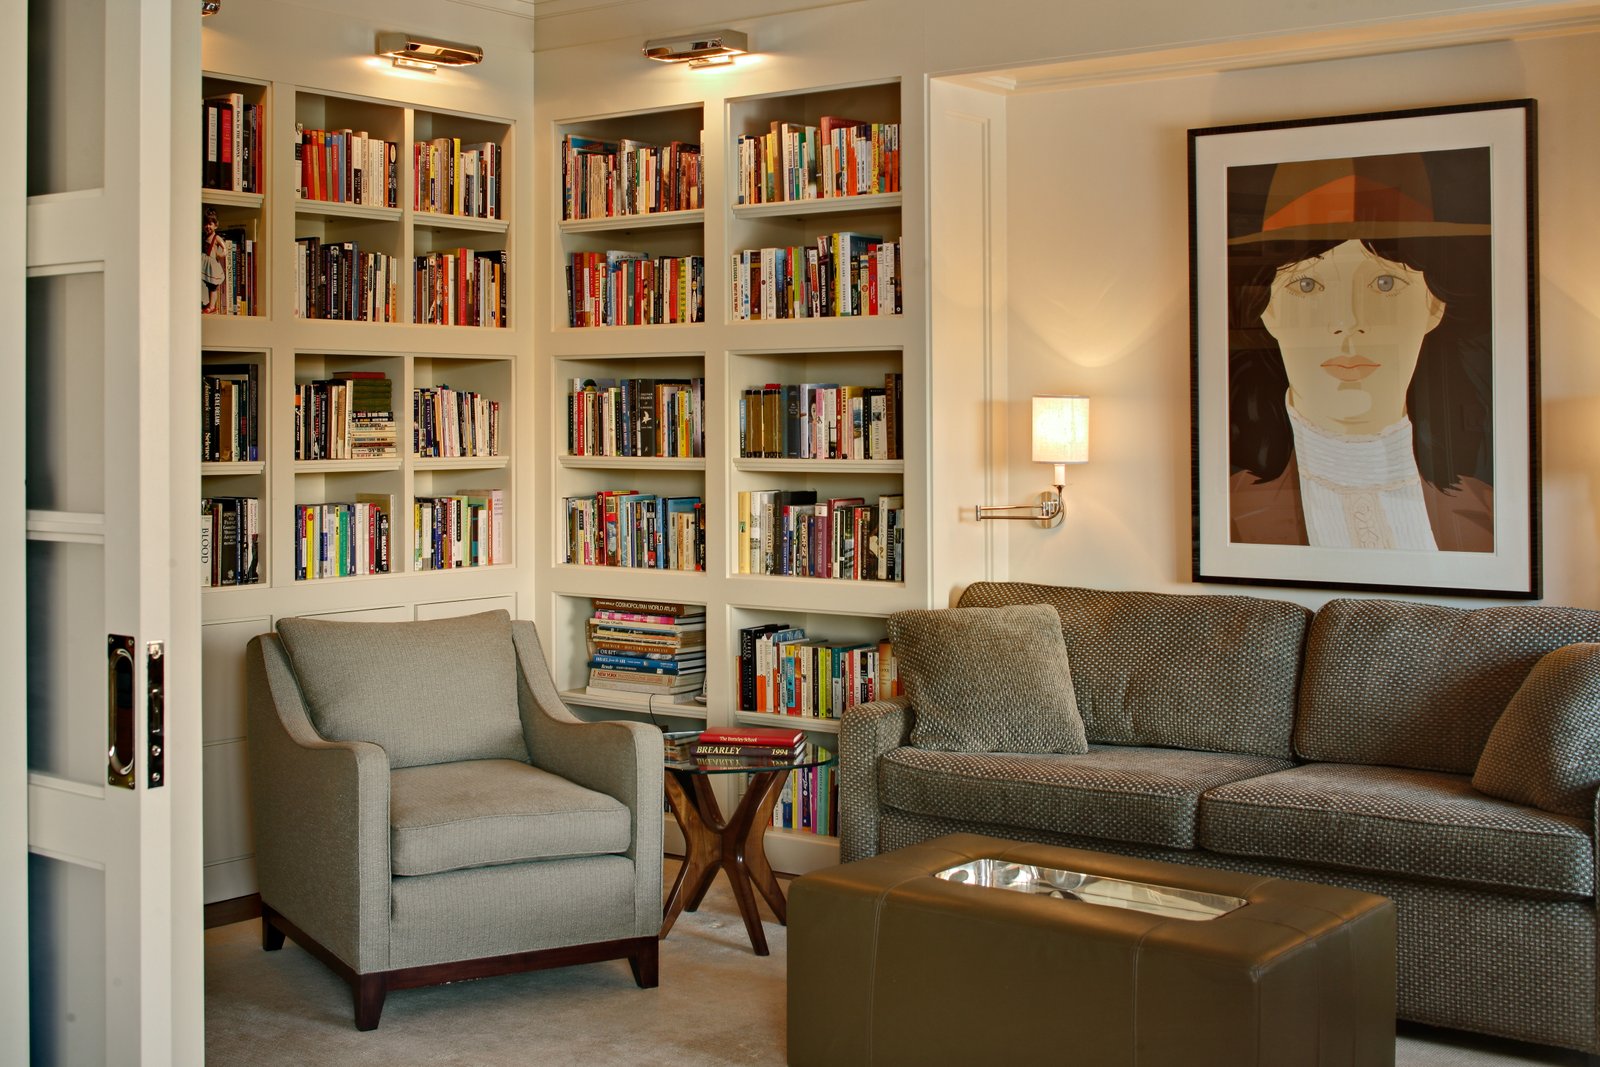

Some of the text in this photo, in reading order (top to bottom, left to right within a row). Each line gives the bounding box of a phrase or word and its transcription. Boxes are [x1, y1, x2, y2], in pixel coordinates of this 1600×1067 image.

[201, 528, 209, 564] BLOOD
[615, 601, 648, 610] COSMOPOLITAN
[696, 746, 789, 756] BREARLEY 1994
